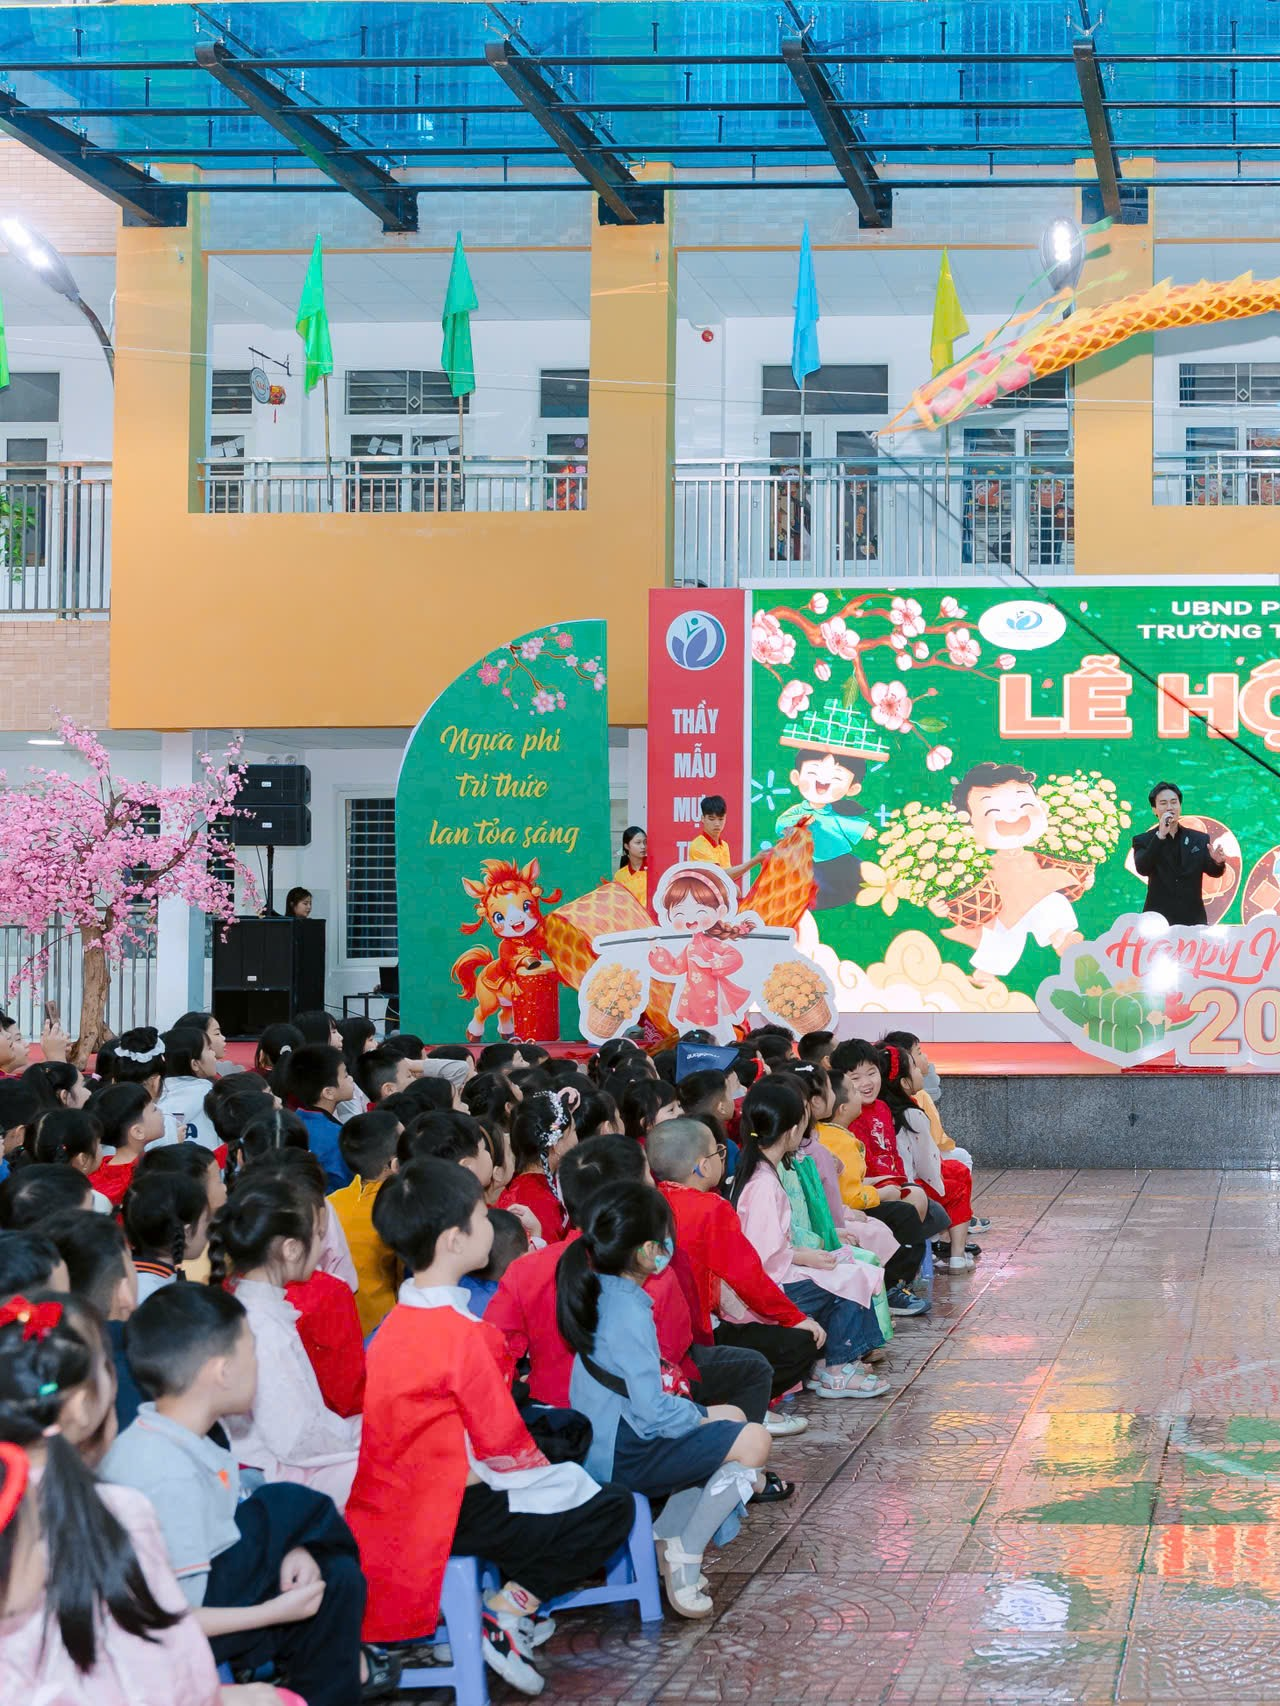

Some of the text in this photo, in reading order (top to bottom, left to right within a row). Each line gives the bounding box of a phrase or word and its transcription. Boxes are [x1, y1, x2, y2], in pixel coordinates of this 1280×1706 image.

[1171, 600, 1253, 616] UBND
[1137, 621, 1263, 639] TRƯỜNG
[1000, 654, 1133, 739] LỄ
[672, 700, 719, 734] THẦY
[440, 725, 561, 760] Ngựa phi
[673, 743, 717, 778] MẪU
[491, 772, 549, 798] thức
[673, 794, 706, 828] MỰ
[429, 818, 580, 853] lan tỏa sáng
